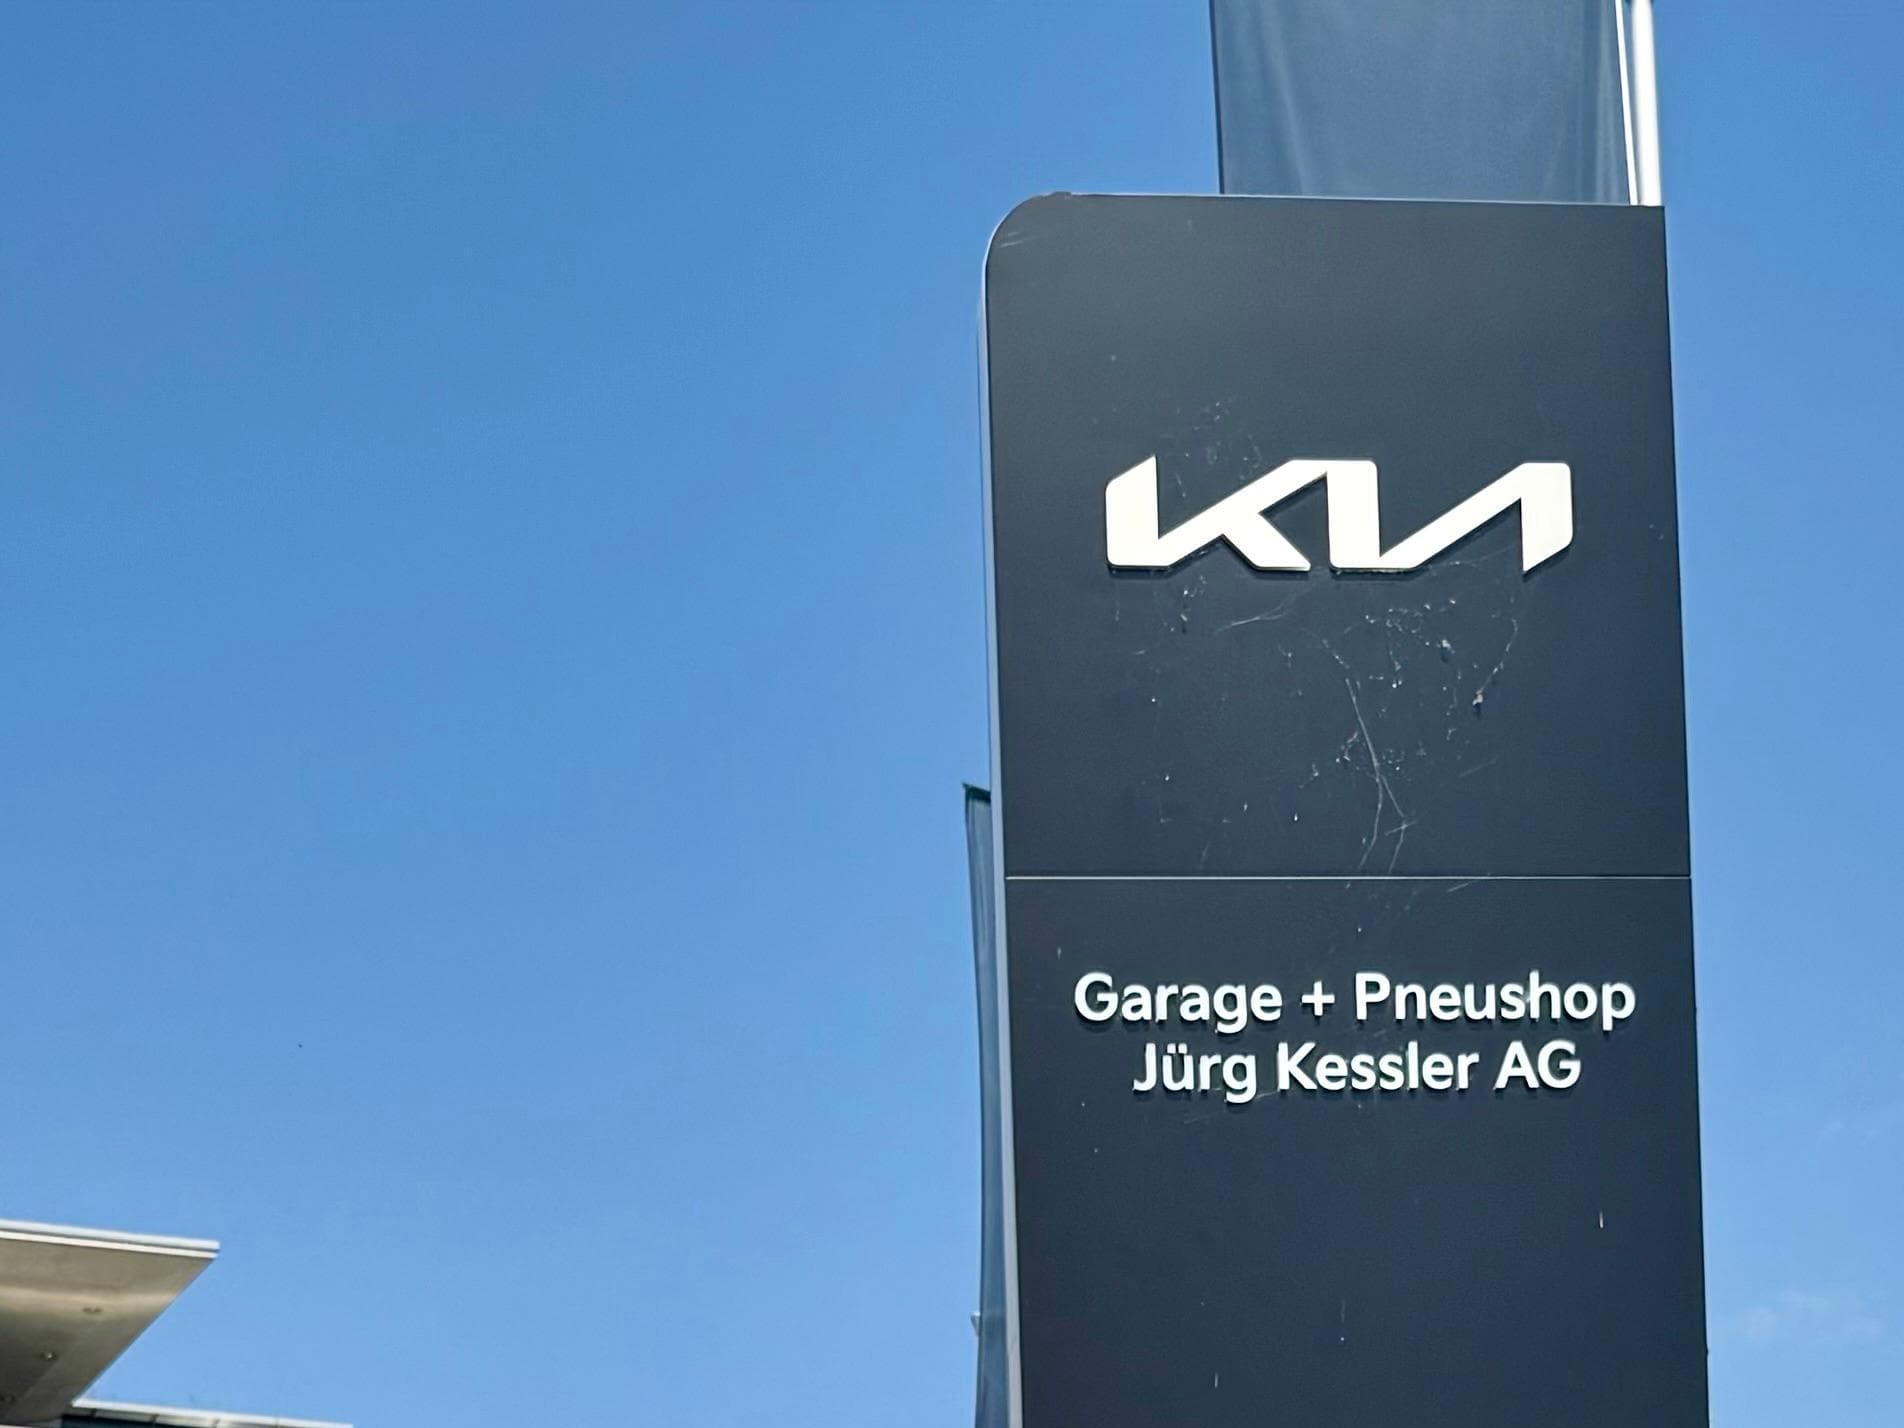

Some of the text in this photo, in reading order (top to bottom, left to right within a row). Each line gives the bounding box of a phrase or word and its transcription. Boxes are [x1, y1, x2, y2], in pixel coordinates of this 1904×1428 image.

[1105, 455, 1574, 573] KIA
[1073, 970, 1637, 1034] Garage + Pneushop
[1132, 1040, 1582, 1103] Jürg Kessler AG
